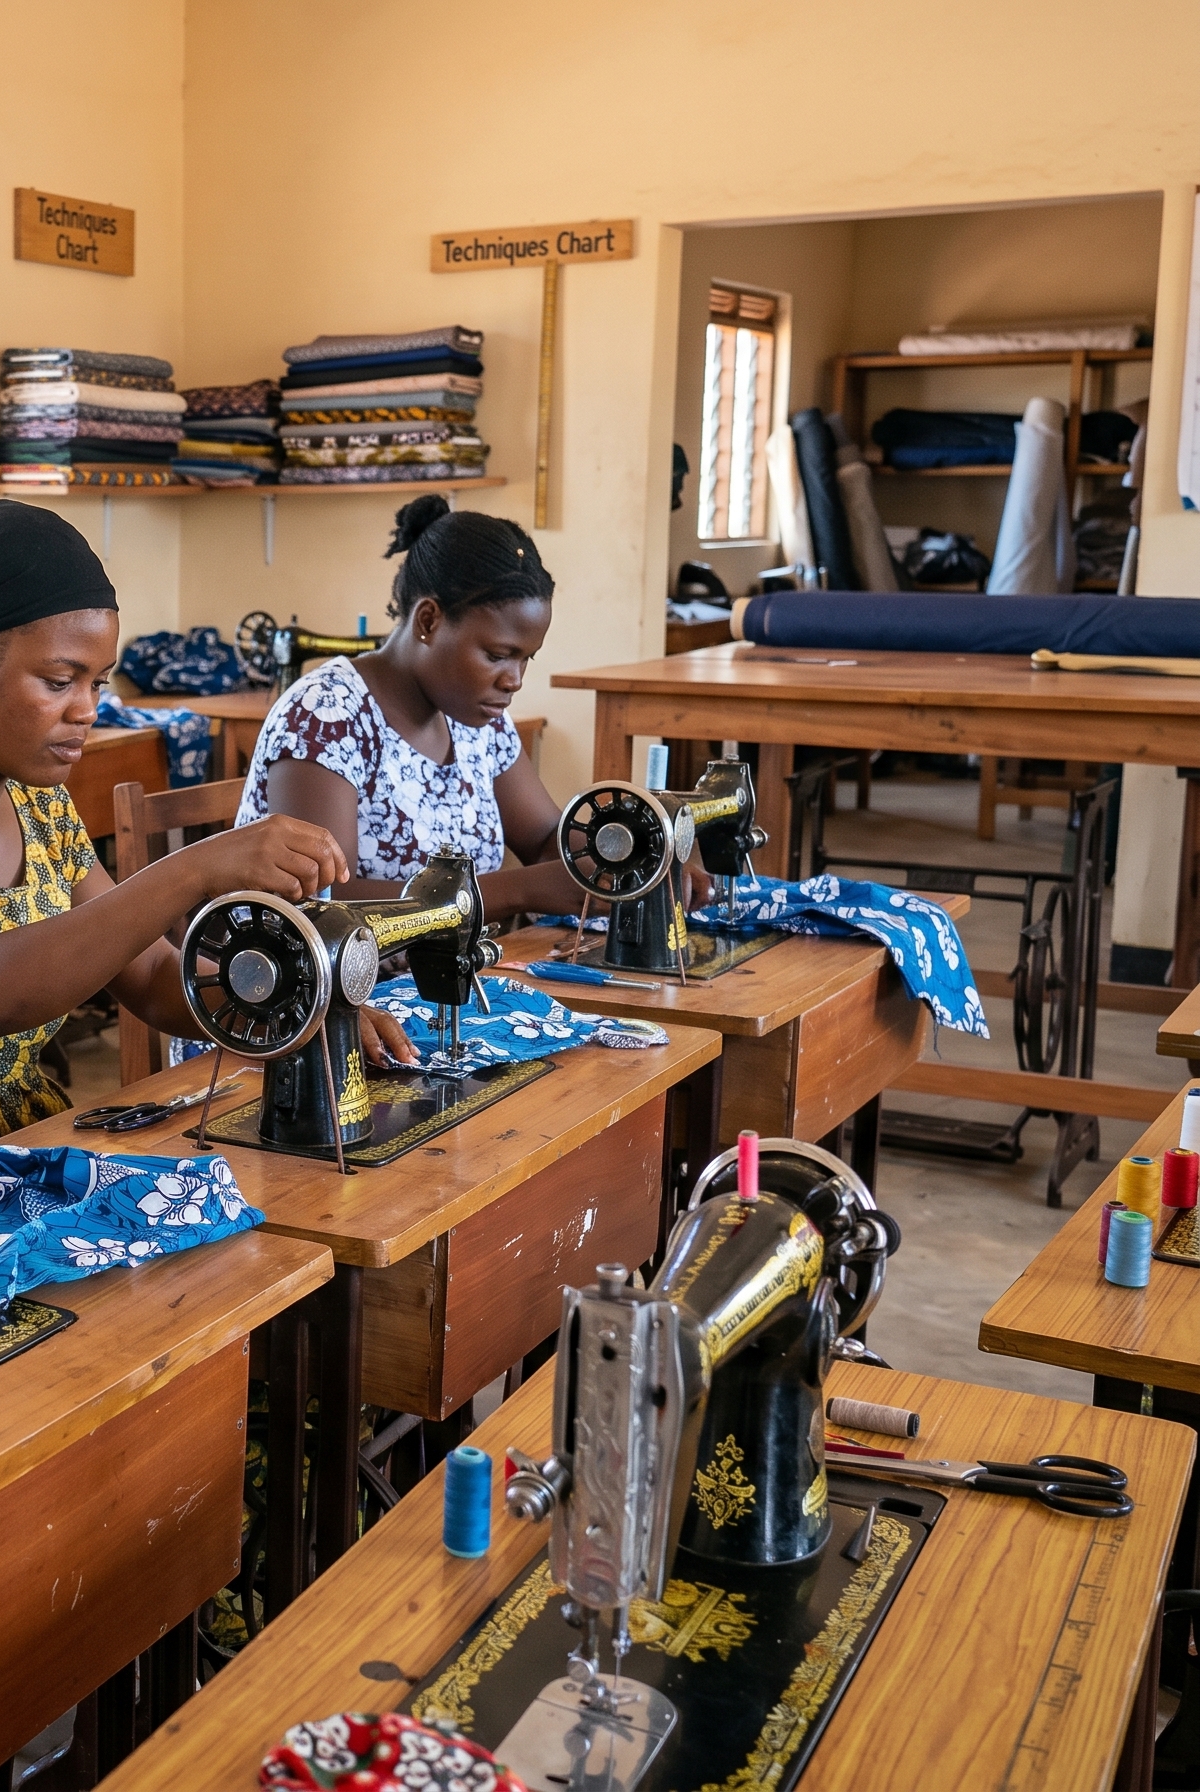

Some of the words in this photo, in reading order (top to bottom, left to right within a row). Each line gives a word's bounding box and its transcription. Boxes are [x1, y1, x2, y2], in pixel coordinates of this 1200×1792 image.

[37, 197, 117, 239] Techniques
[56, 233, 99, 265] Chart
[442, 236, 549, 266] Techniques
[556, 227, 615, 254] Chart
